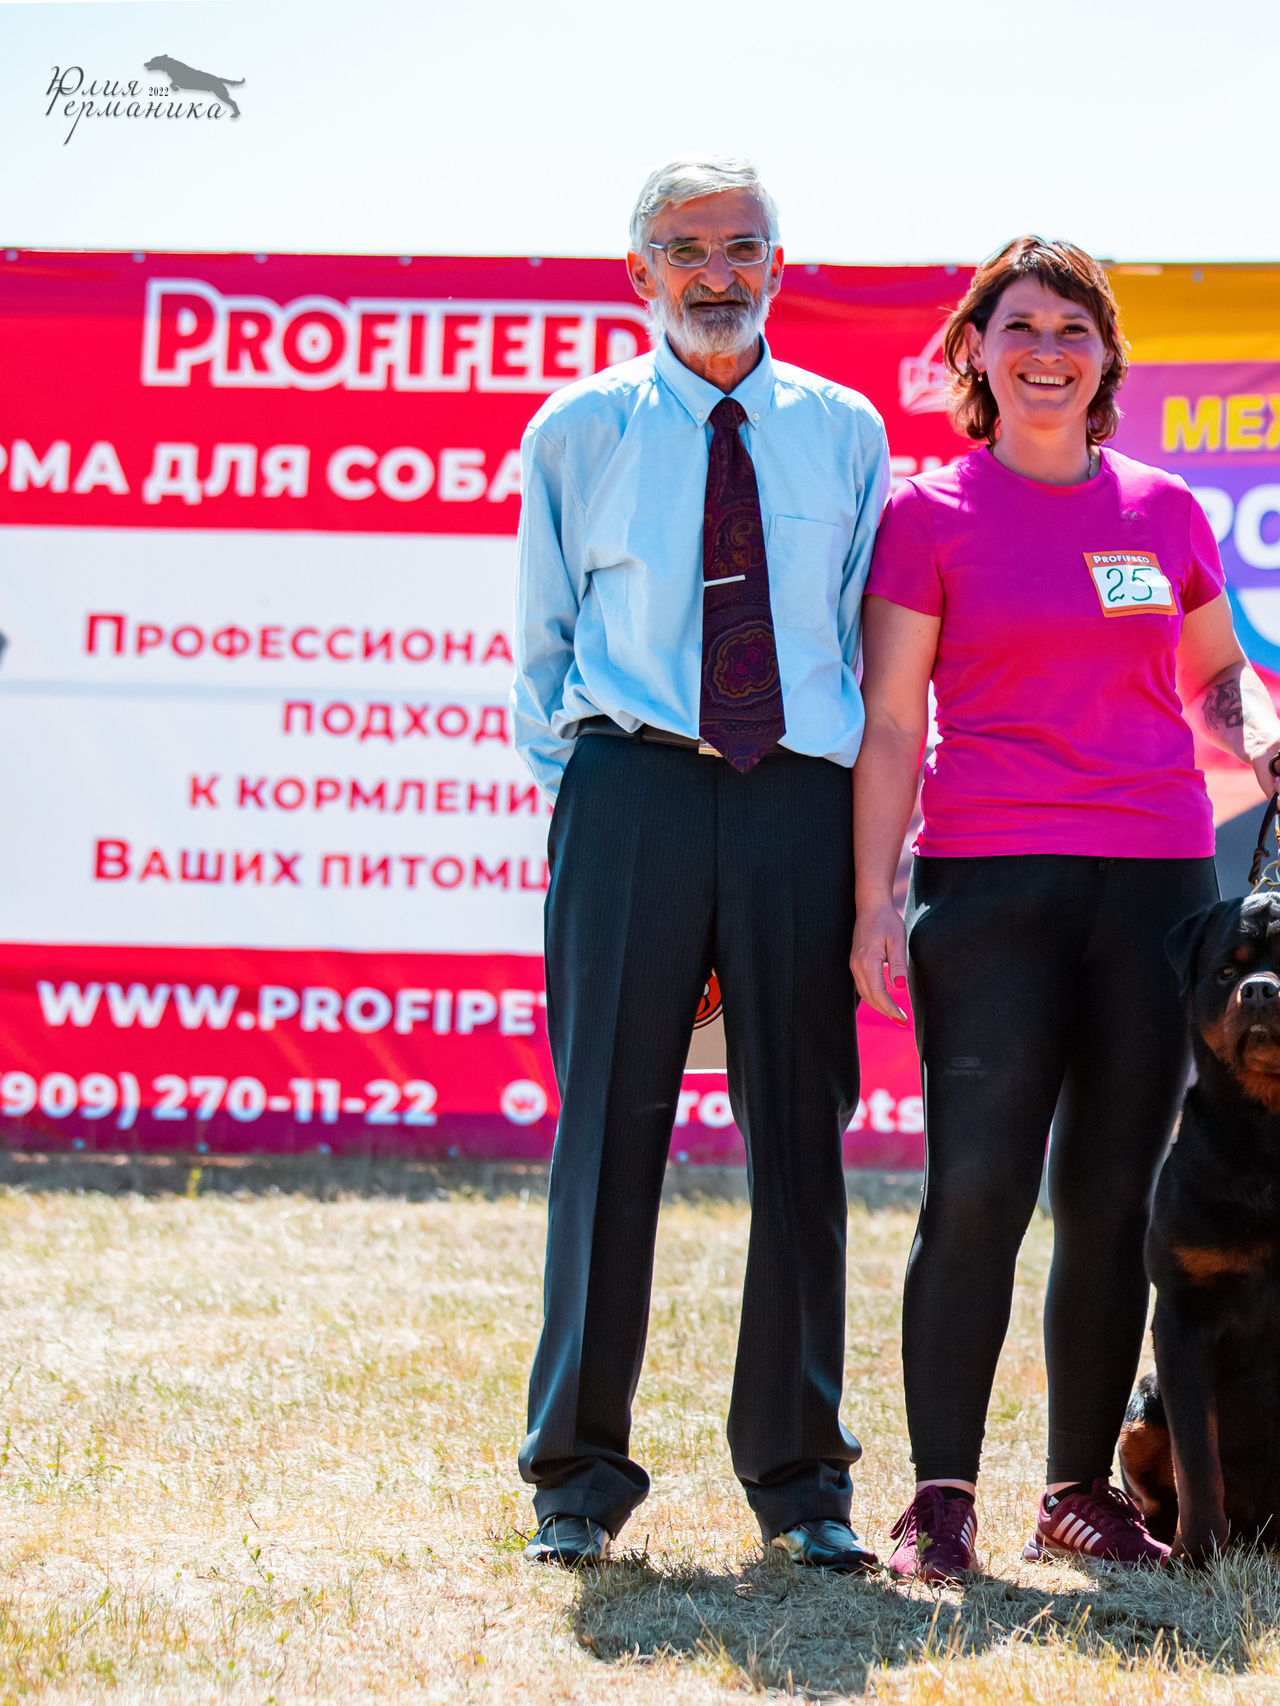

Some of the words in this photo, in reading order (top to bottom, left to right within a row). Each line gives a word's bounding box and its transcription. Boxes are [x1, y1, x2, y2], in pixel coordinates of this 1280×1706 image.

[0, 439, 131, 496] МА
[144, 443, 310, 504] ДЛЯ
[1106, 568, 1152, 602] 25
[282, 701, 510, 745] ПОДХОД
[189, 774, 217, 809] К
[237, 776, 554, 815] КОРМЛЕНИ
[37, 980, 547, 1036] WWW.PROFIPE
[152, 1074, 438, 1126] 270-11-22
